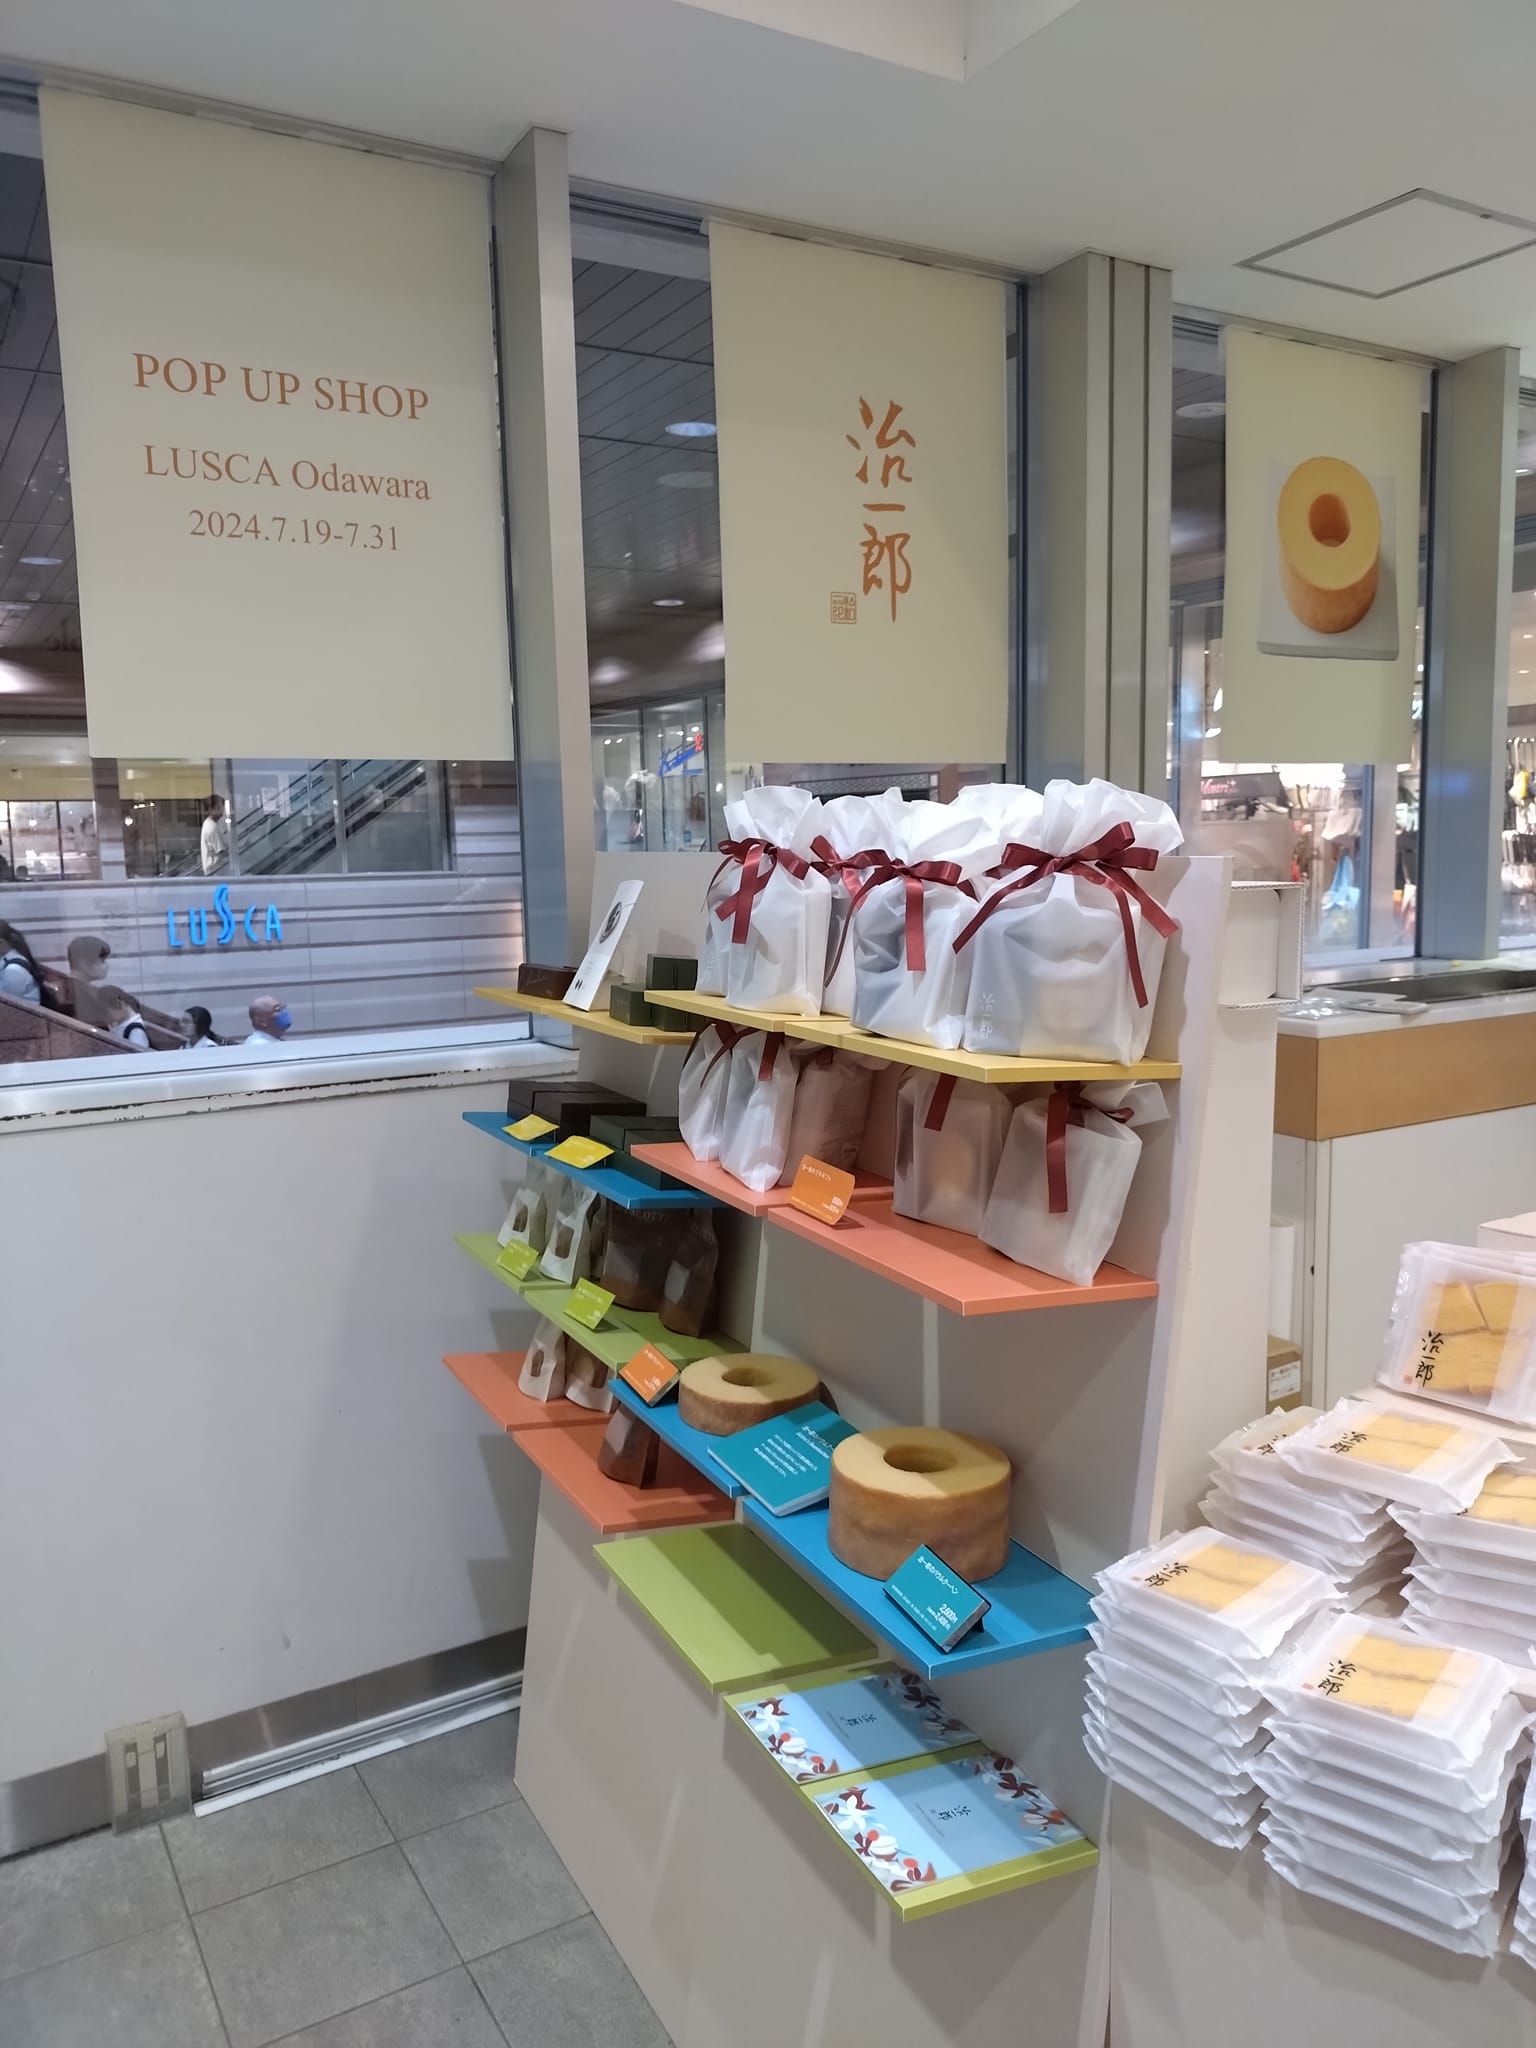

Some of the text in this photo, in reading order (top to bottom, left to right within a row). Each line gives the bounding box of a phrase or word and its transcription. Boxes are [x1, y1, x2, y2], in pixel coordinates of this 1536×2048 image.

[133, 353, 429, 420] POP UP SHOP
[143, 445, 430, 500] LUSCA Odawara
[189, 510, 399, 551] 2024.7.19-7.31
[846, 395, 915, 622] 治一郎
[167, 882, 284, 946] LUSCA
[1415, 1329, 1445, 1388] 治一郎
[1329, 1431, 1368, 1454] 治一郎
[1144, 1561, 1190, 1588] 治一郎
[1318, 1659, 1357, 1696] 治一郎
